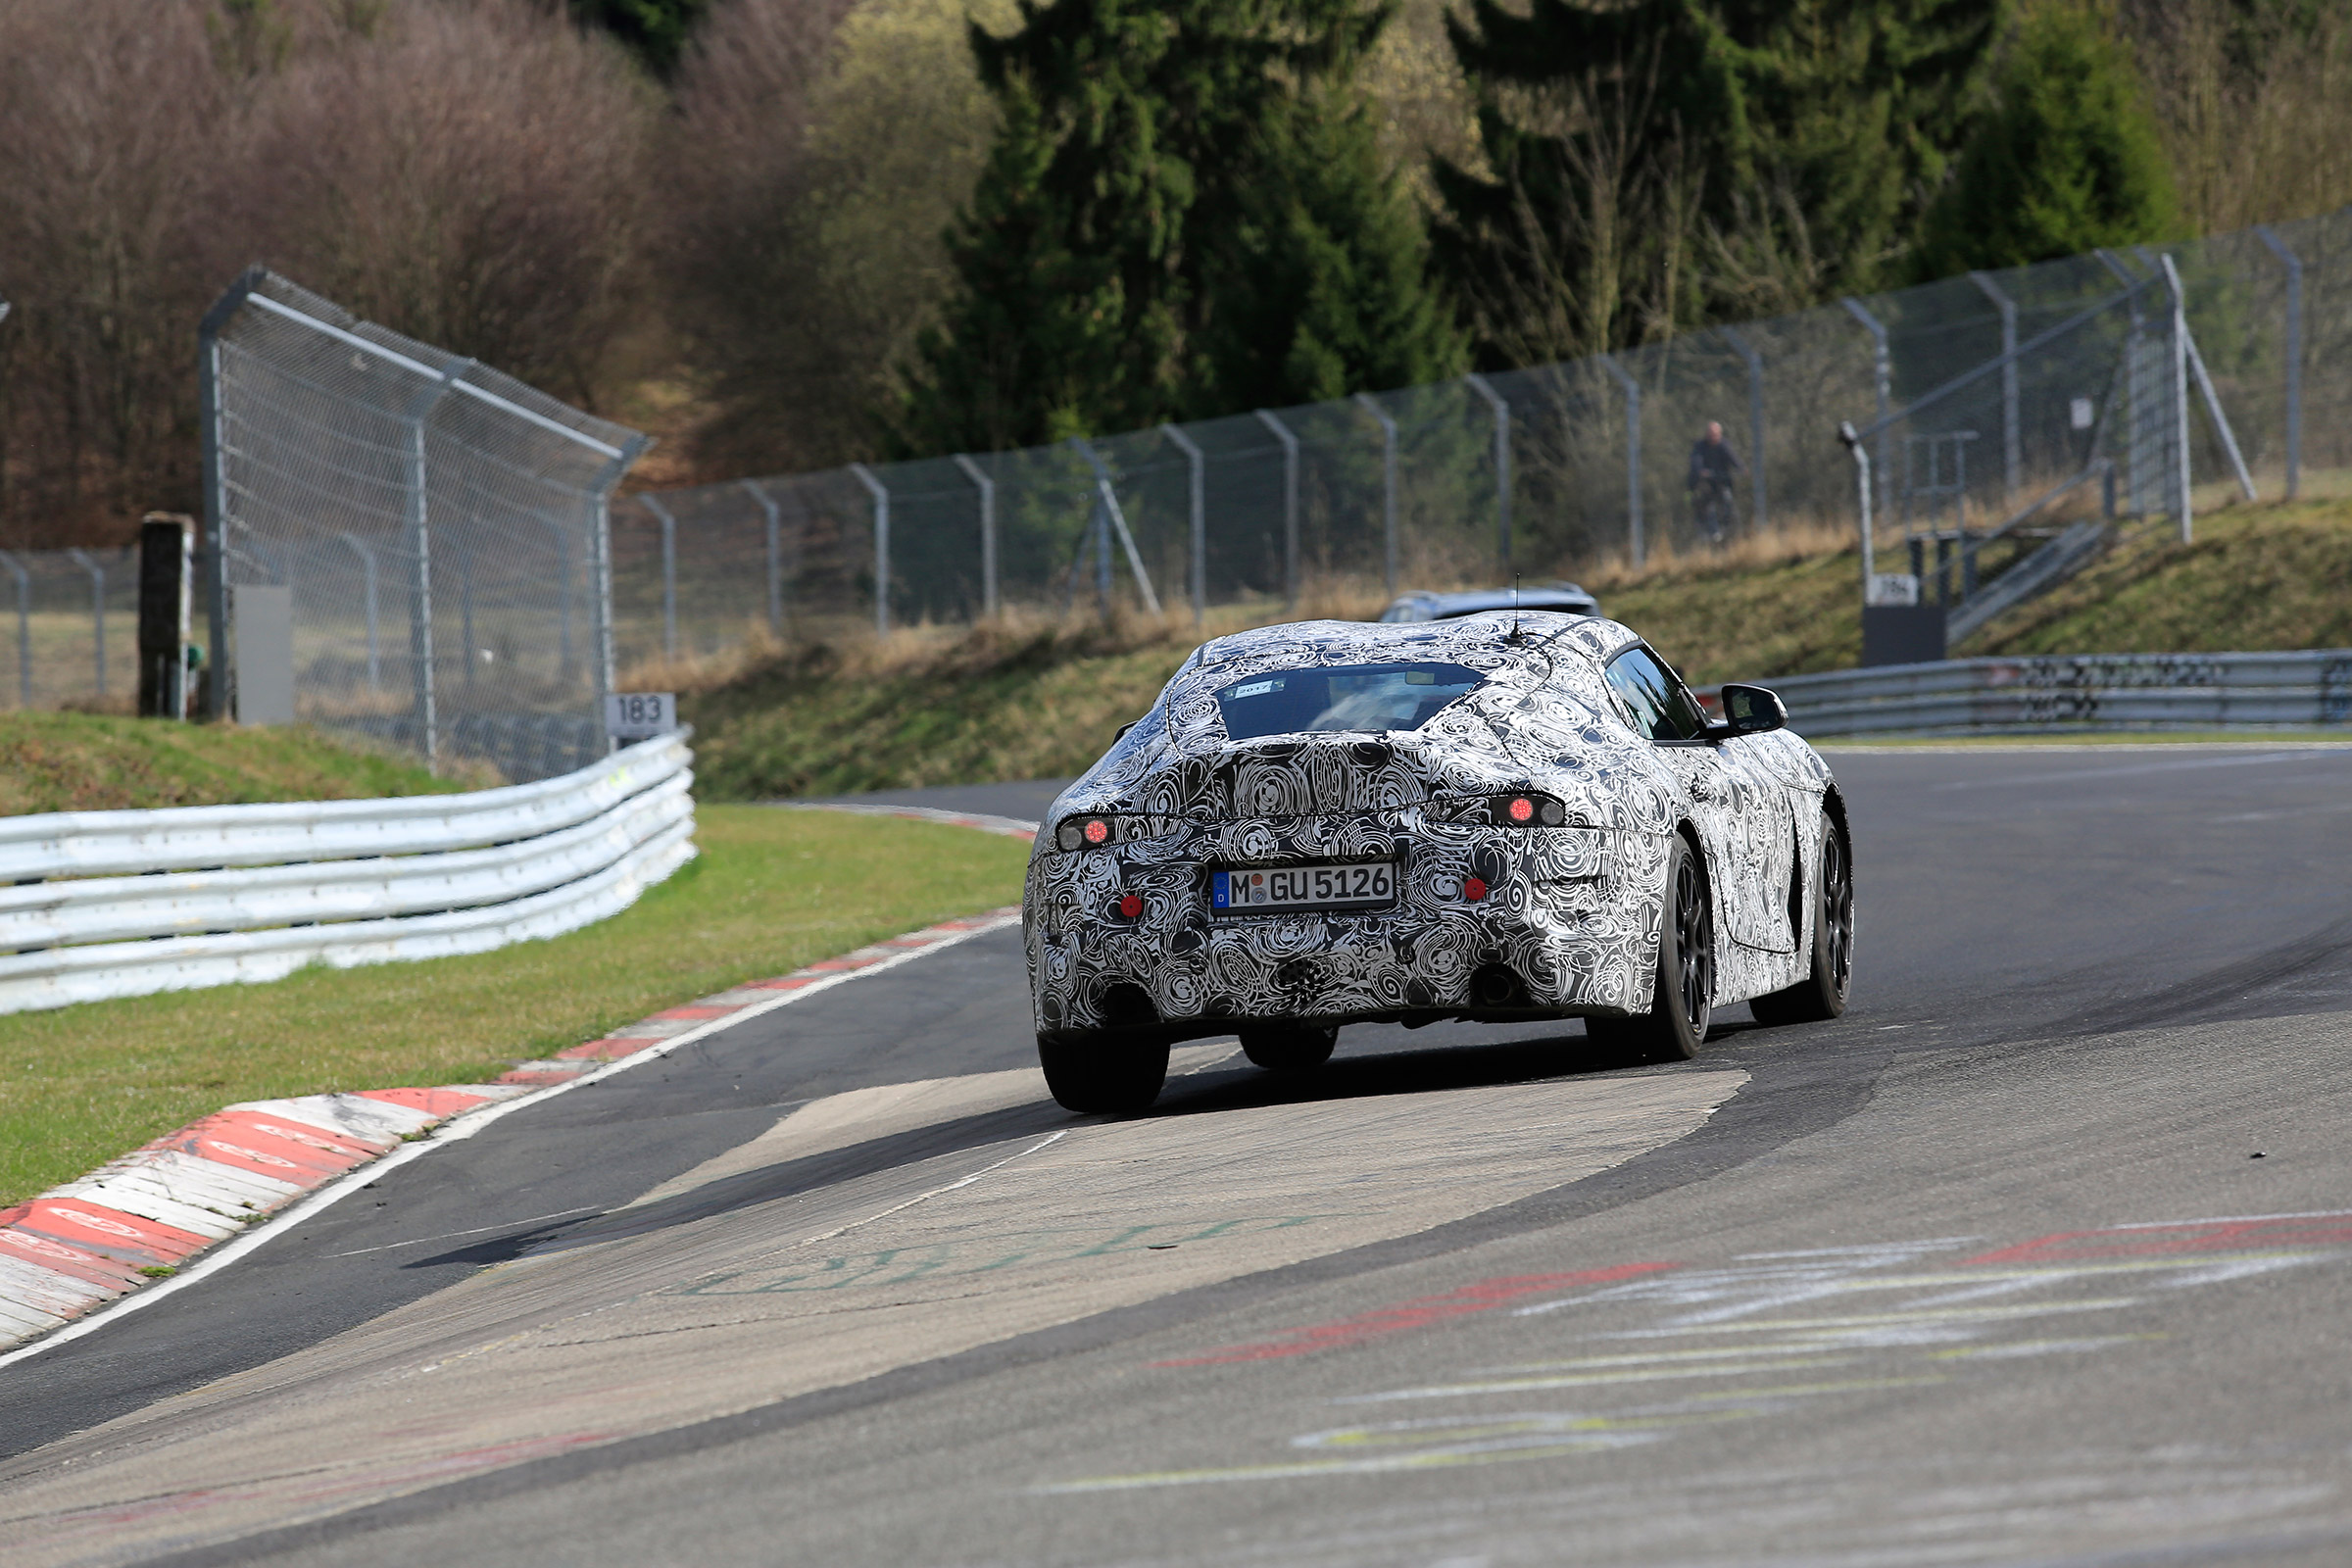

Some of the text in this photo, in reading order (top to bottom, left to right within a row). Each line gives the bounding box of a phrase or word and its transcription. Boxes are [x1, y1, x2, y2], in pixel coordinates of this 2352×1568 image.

[618, 695, 662, 724] 183
[1217, 893, 1225, 903] D
[1231, 867, 1390, 904] M GU 5126
